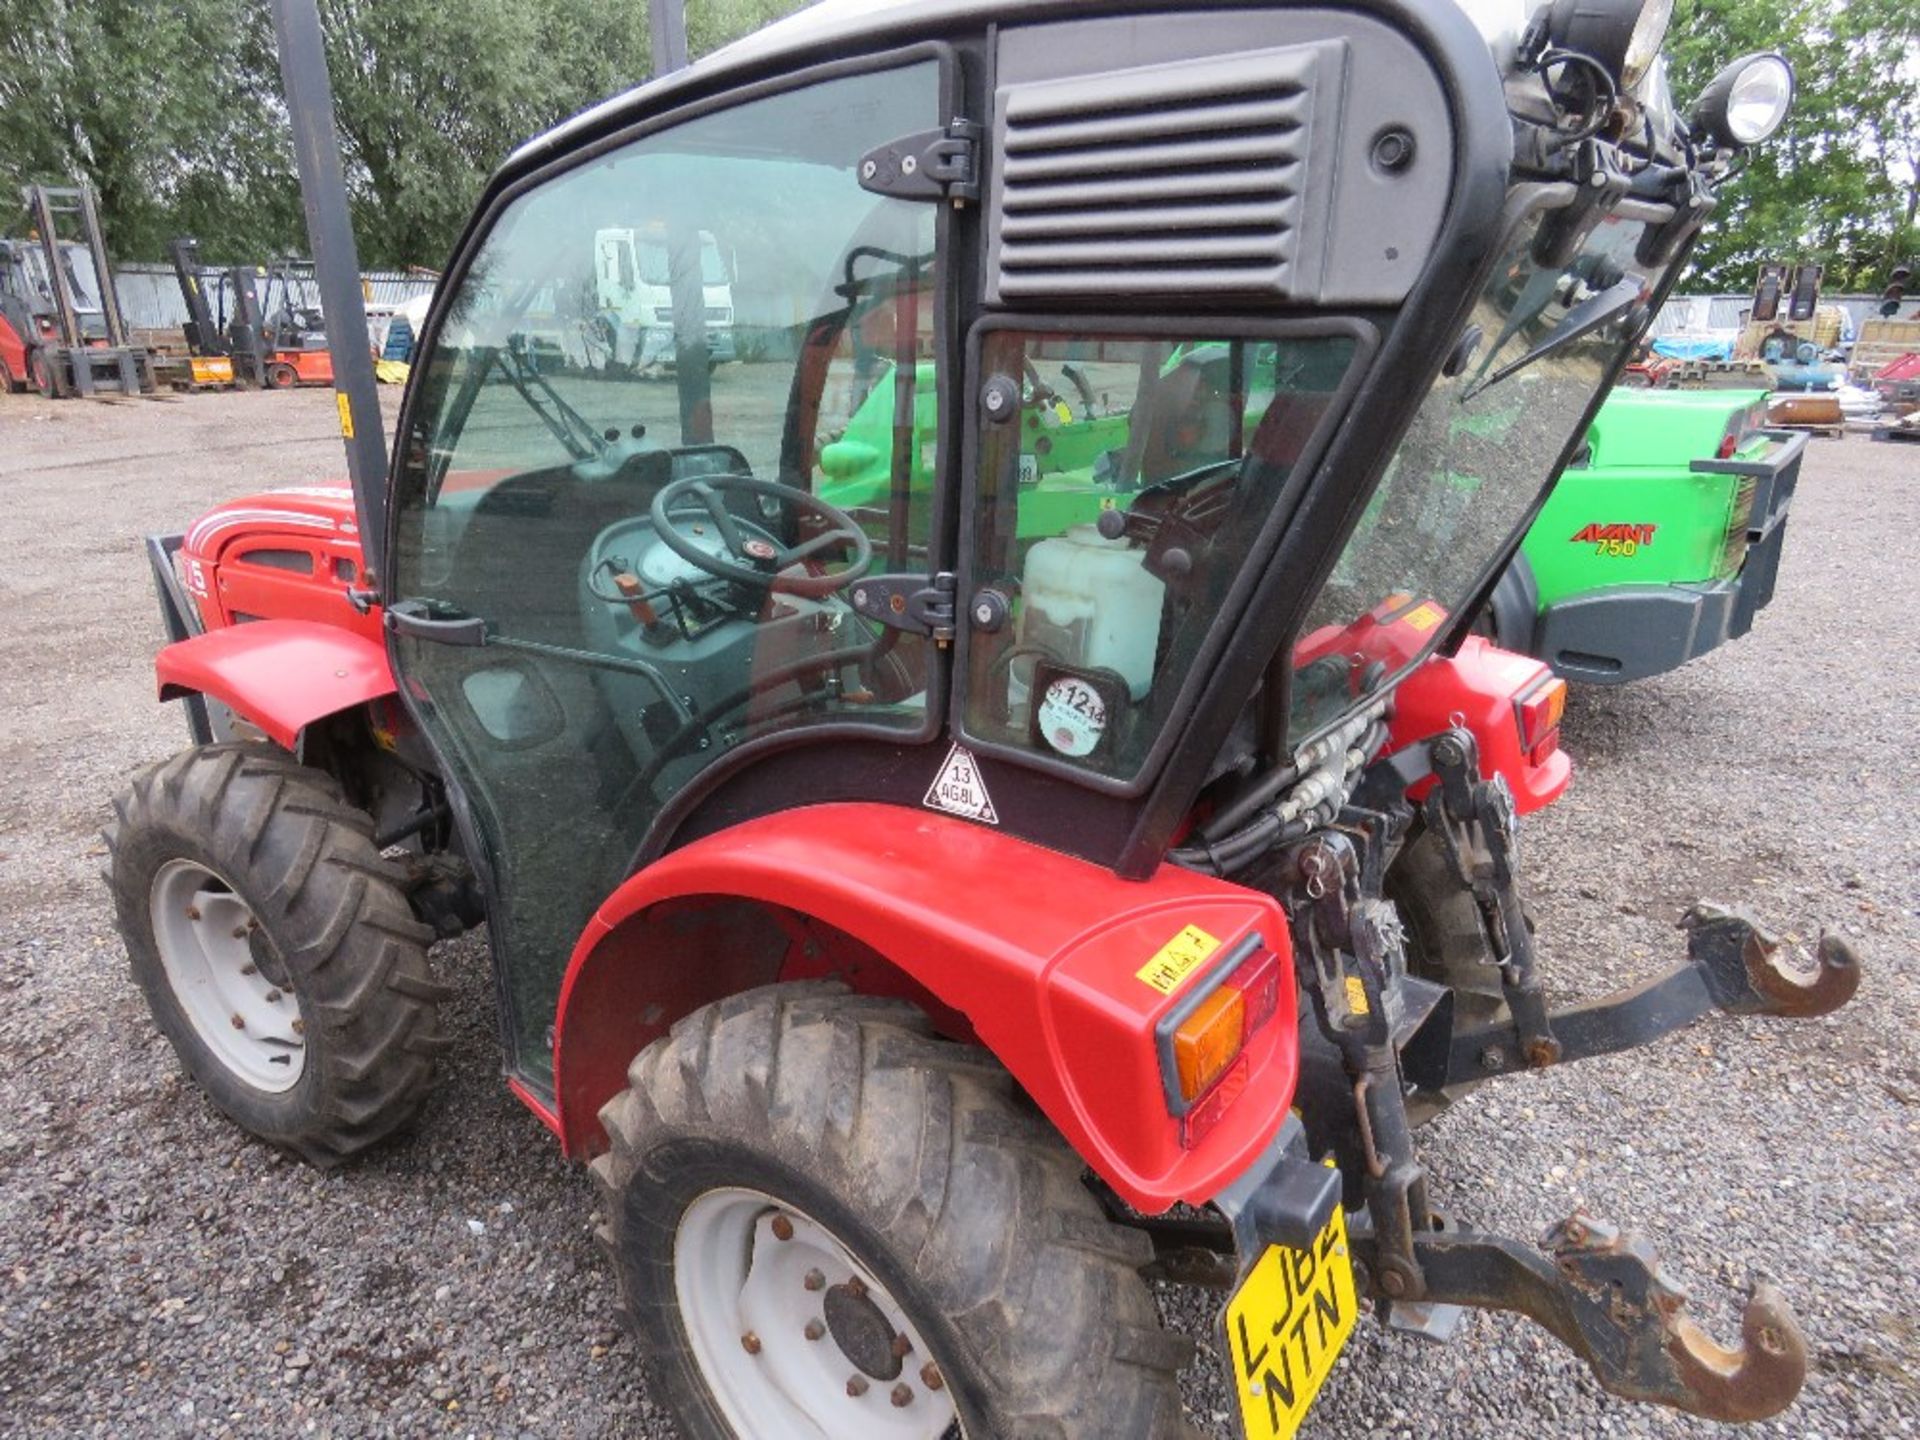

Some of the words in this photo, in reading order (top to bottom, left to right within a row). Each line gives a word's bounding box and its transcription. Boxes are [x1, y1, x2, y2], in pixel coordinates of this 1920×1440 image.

[1569, 522, 1657, 546] AVANT
[1595, 538, 1637, 557] 750
[1067, 685, 1090, 715] 12
[952, 765, 971, 784] 13
[1263, 1265, 1341, 1435] NTN
